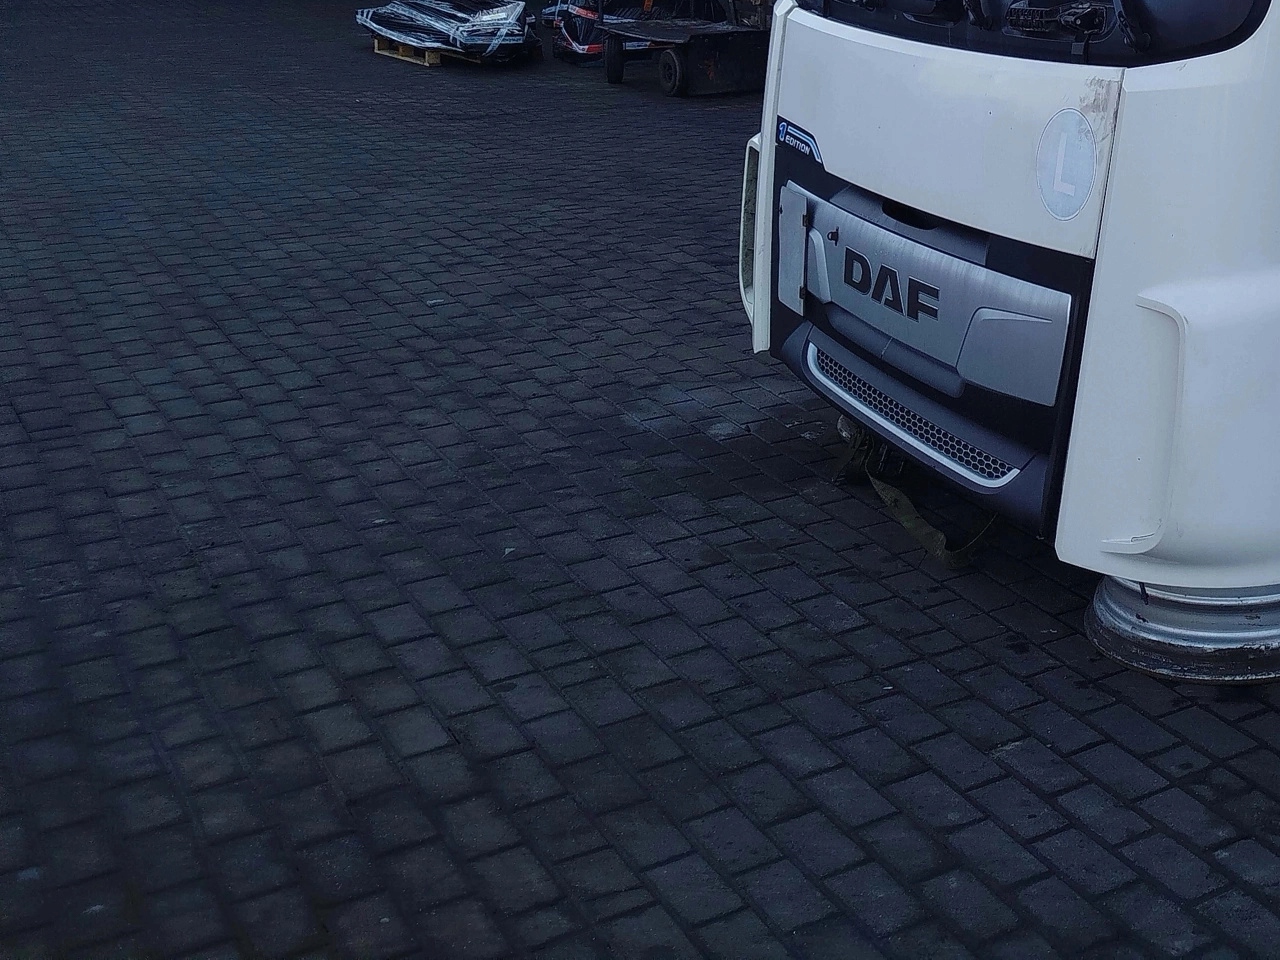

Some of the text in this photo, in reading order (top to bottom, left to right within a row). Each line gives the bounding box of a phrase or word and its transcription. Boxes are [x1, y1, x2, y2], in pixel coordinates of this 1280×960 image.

[785, 135, 811, 156] EDITION
[1053, 132, 1076, 197] L
[843, 246, 940, 323] DAF
